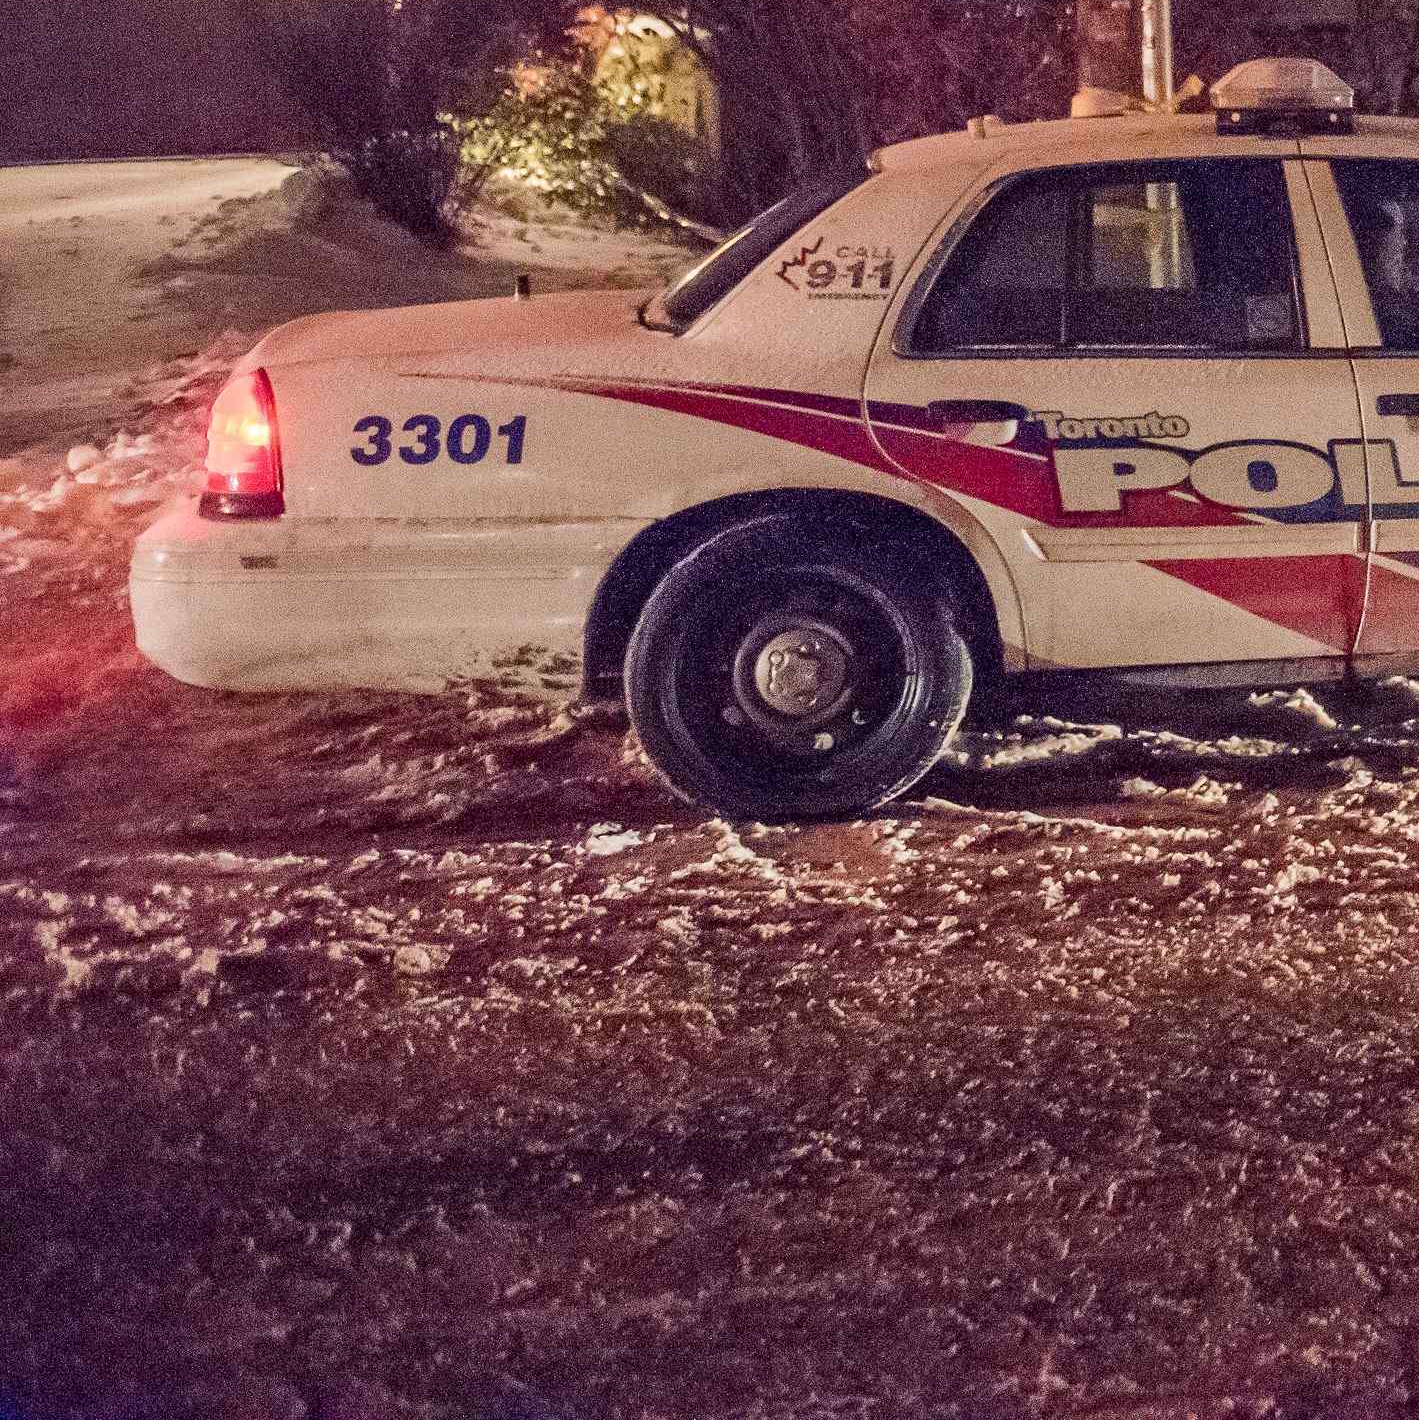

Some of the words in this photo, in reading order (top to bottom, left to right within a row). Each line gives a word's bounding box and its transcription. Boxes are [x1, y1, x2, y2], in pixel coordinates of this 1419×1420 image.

[836, 245, 895, 259] CALL
[1034, 409, 1191, 439] Toronto
[350, 413, 527, 467] 3301
